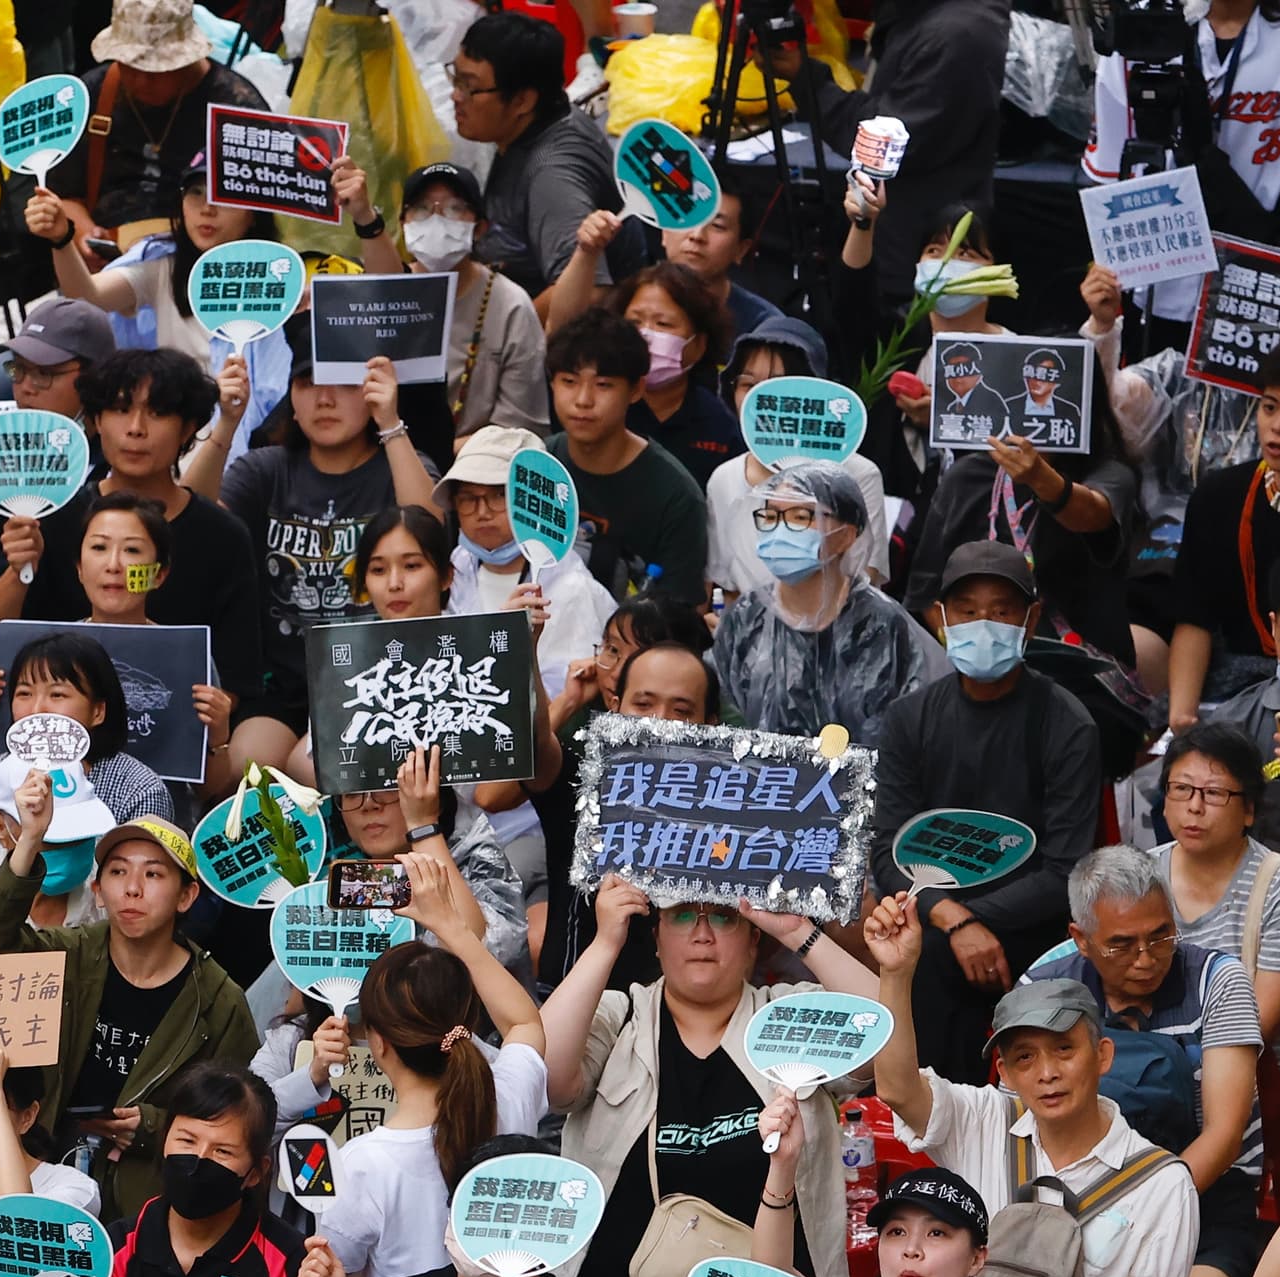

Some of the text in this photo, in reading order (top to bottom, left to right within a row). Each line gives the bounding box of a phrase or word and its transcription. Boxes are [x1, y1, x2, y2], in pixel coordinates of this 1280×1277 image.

[222, 123, 295, 153] 無討論
[223, 161, 253, 179] Bô
[202, 260, 267, 280] 我藐視
[200, 282, 286, 300] 藍白黑箱
[349, 303, 365, 312] WE
[366, 303, 386, 312] ARE
[388, 303, 400, 311] SO
[327, 316, 356, 326] THEY
[357, 315, 387, 325] PAINT
[1211, 318, 1254, 349] Bô
[944, 361, 981, 378] 真小人
[606, 760, 842, 814] 我是追星人
[596, 818, 839, 876] 我推的台灣
[472, 1177, 557, 1203] 我藐視
[465, 1202, 579, 1231] 藍白黑箱
